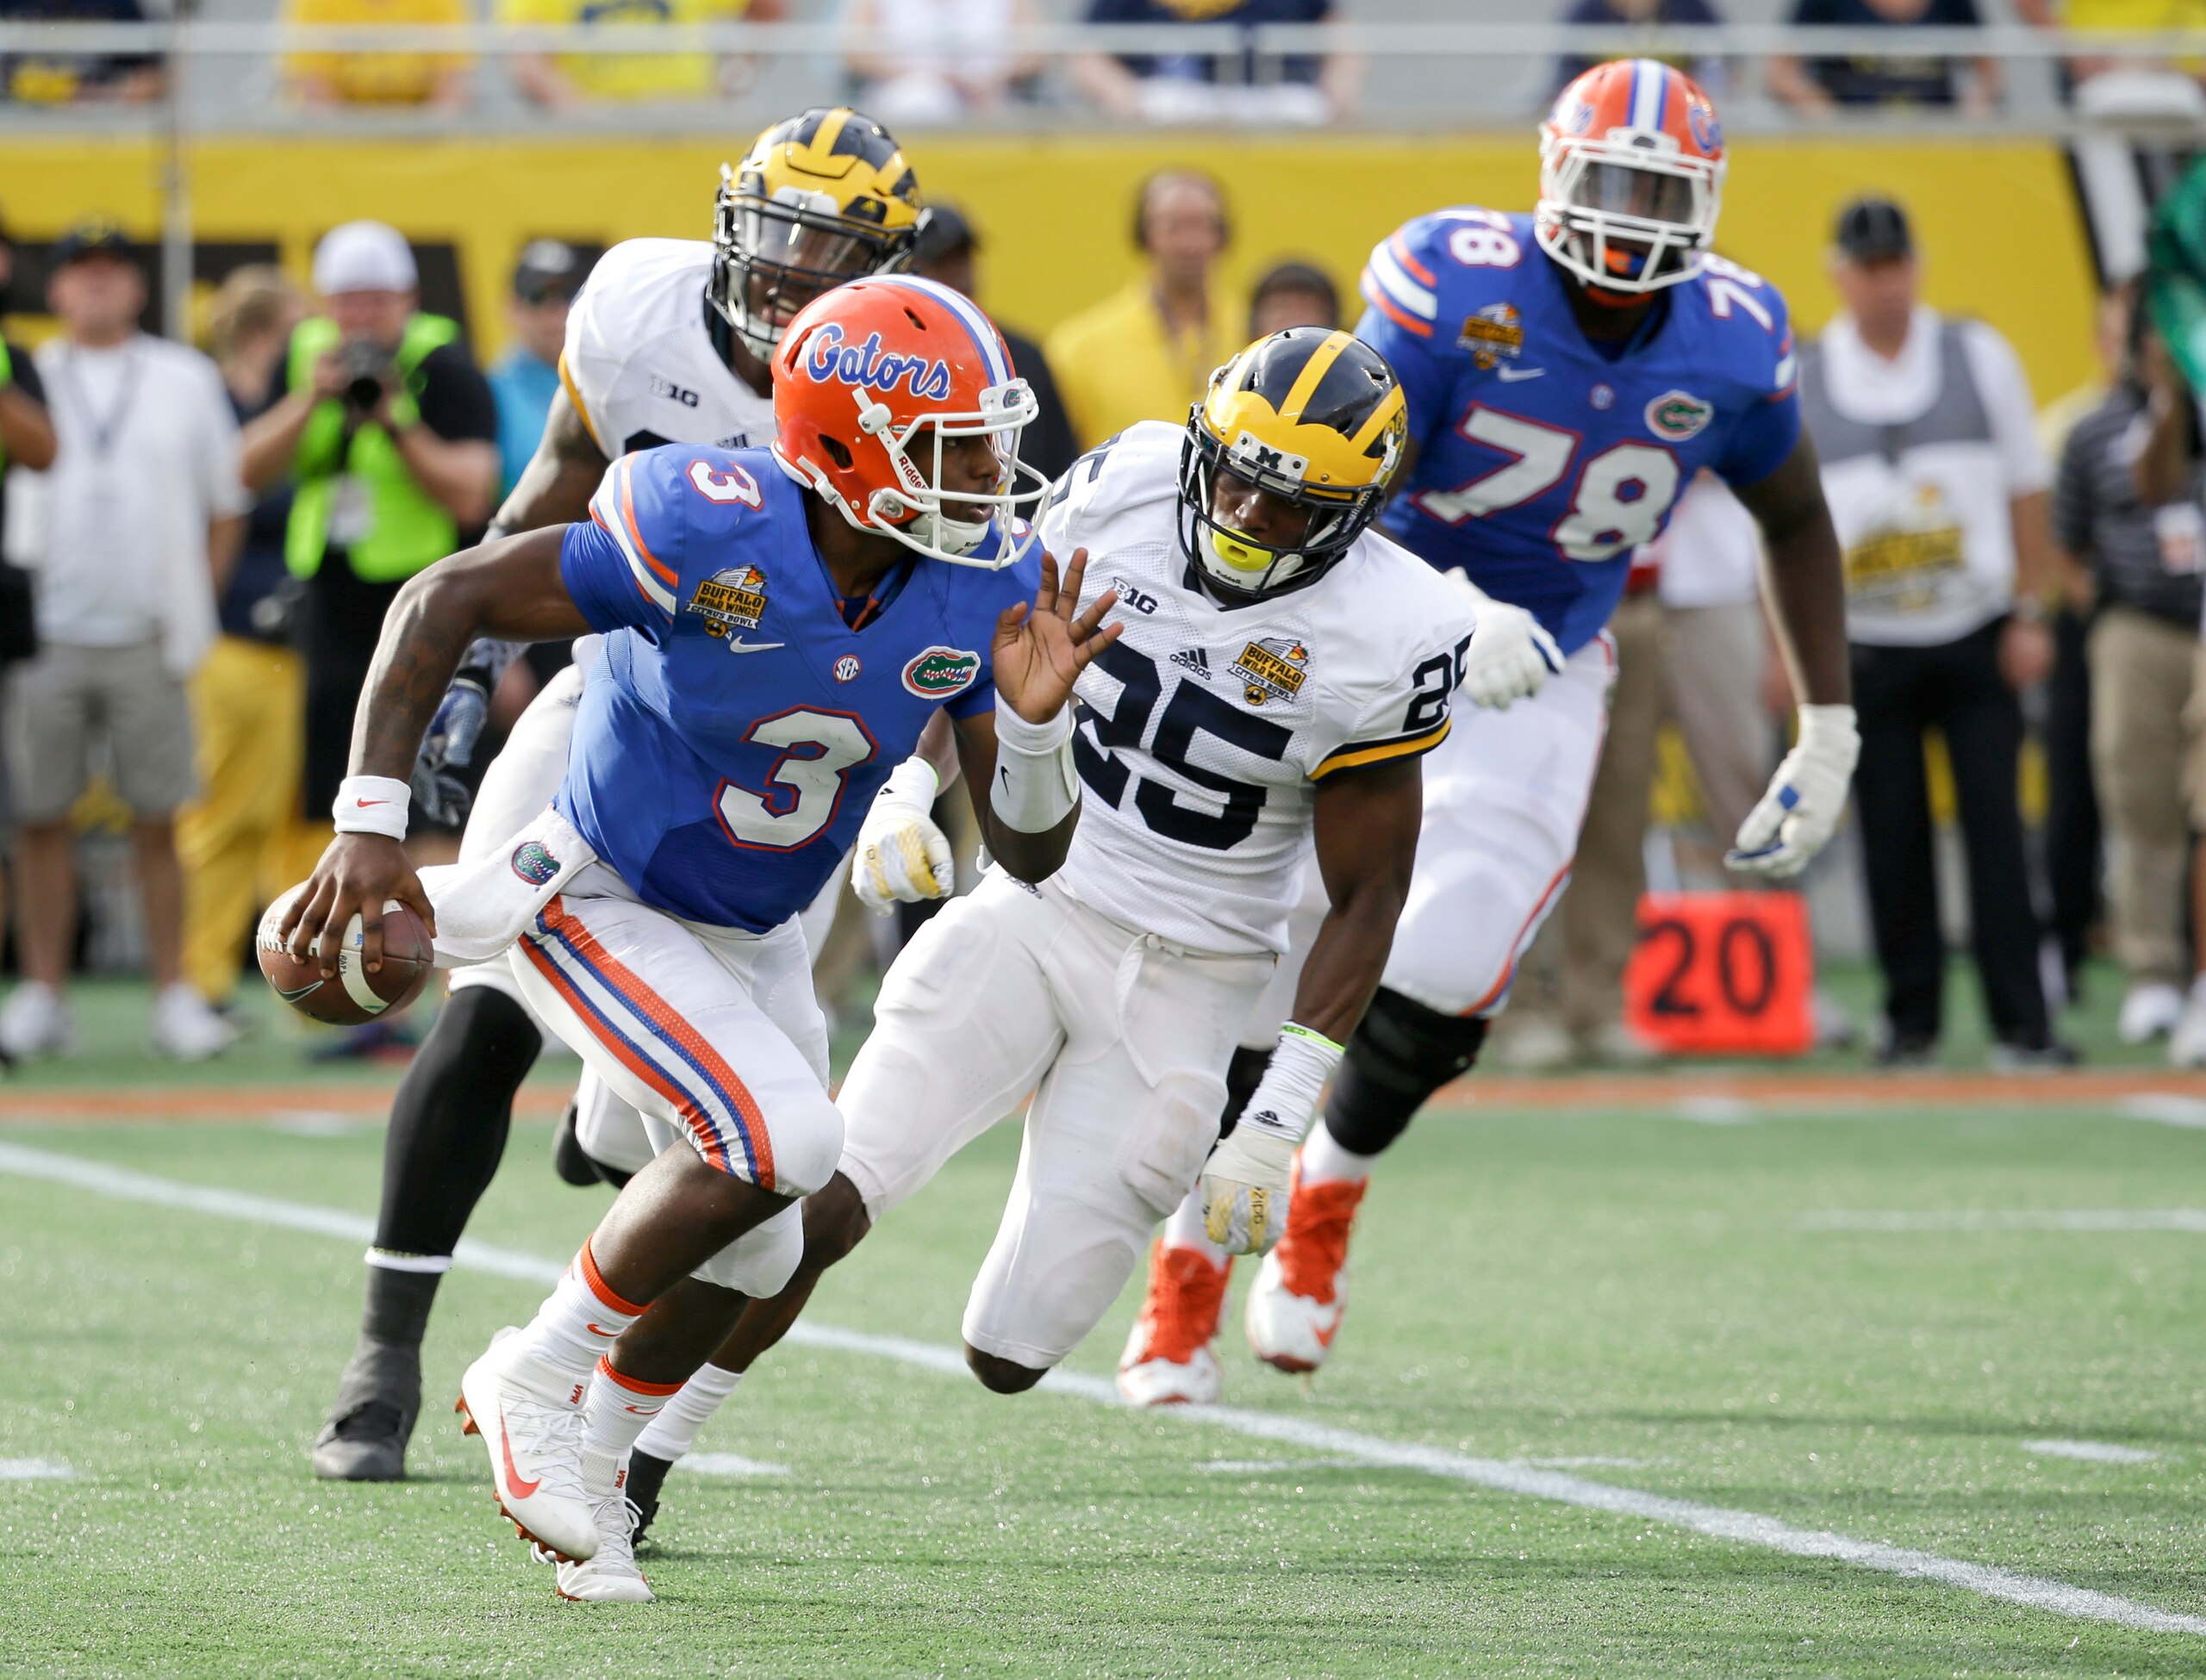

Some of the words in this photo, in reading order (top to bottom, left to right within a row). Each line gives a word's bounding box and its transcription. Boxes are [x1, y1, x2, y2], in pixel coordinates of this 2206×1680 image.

[807, 322, 950, 401] Gators
[1256, 445, 1283, 470] M
[686, 460, 765, 512] 3
[1413, 401, 1682, 562] 78
[697, 594, 723, 609] WILD
[725, 602, 759, 618] WINGS
[700, 582, 763, 608] BUFFALO
[690, 605, 726, 619] CITRUS
[726, 613, 754, 627] BOWL
[836, 656, 860, 681] SEC
[1169, 653, 1212, 681] adidas
[1234, 665, 1266, 687] CITRUS
[1266, 683, 1291, 700] BOWL
[1243, 656, 1266, 675] WILD
[1265, 668, 1297, 692] WINGS
[1247, 646, 1302, 684] BUFFALO
[1071, 625, 1294, 851] 25
[713, 706, 881, 853] 3
[1639, 918, 1775, 1017] 20
[570, 1384, 584, 1404] VPR
[614, 1470, 626, 1489] VPR
